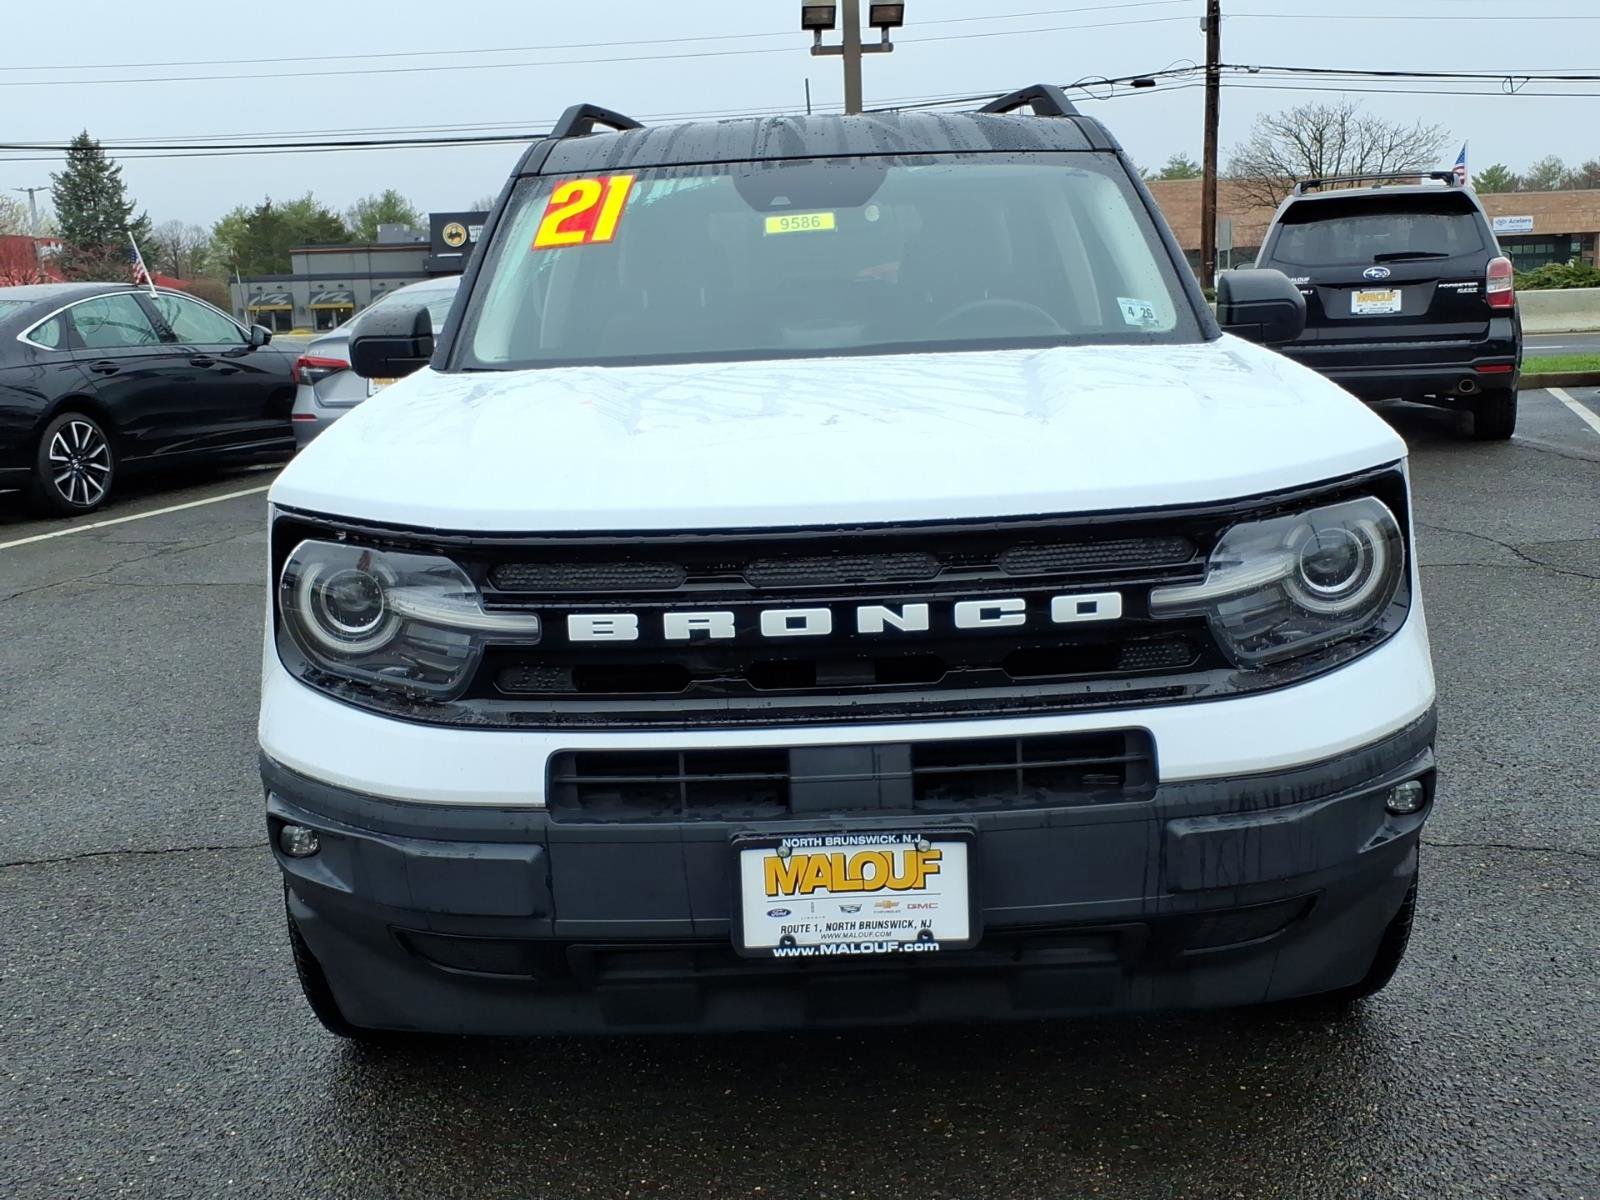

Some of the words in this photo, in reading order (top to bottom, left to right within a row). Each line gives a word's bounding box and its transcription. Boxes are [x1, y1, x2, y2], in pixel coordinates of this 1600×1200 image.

[533, 174, 634, 248] 21
[779, 215, 821, 230] 9586
[1127, 306, 1135, 318] 4
[1140, 307, 1154, 319] 26
[567, 591, 1122, 642] BRONCO
[782, 837, 822, 848] NORTH
[764, 849, 943, 896] MALOUF
[907, 902, 939, 910] GMC
[780, 923, 812, 934] ROUTE
[814, 923, 823, 933] 1,
[825, 921, 857, 931] NORTH
[858, 919, 917, 930] BRUNSWICK,
[920, 919, 933, 928] NJ
[820, 931, 892, 939] WWW.MALOUF.COM
[772, 941, 940, 957] www.MALOUF.com
